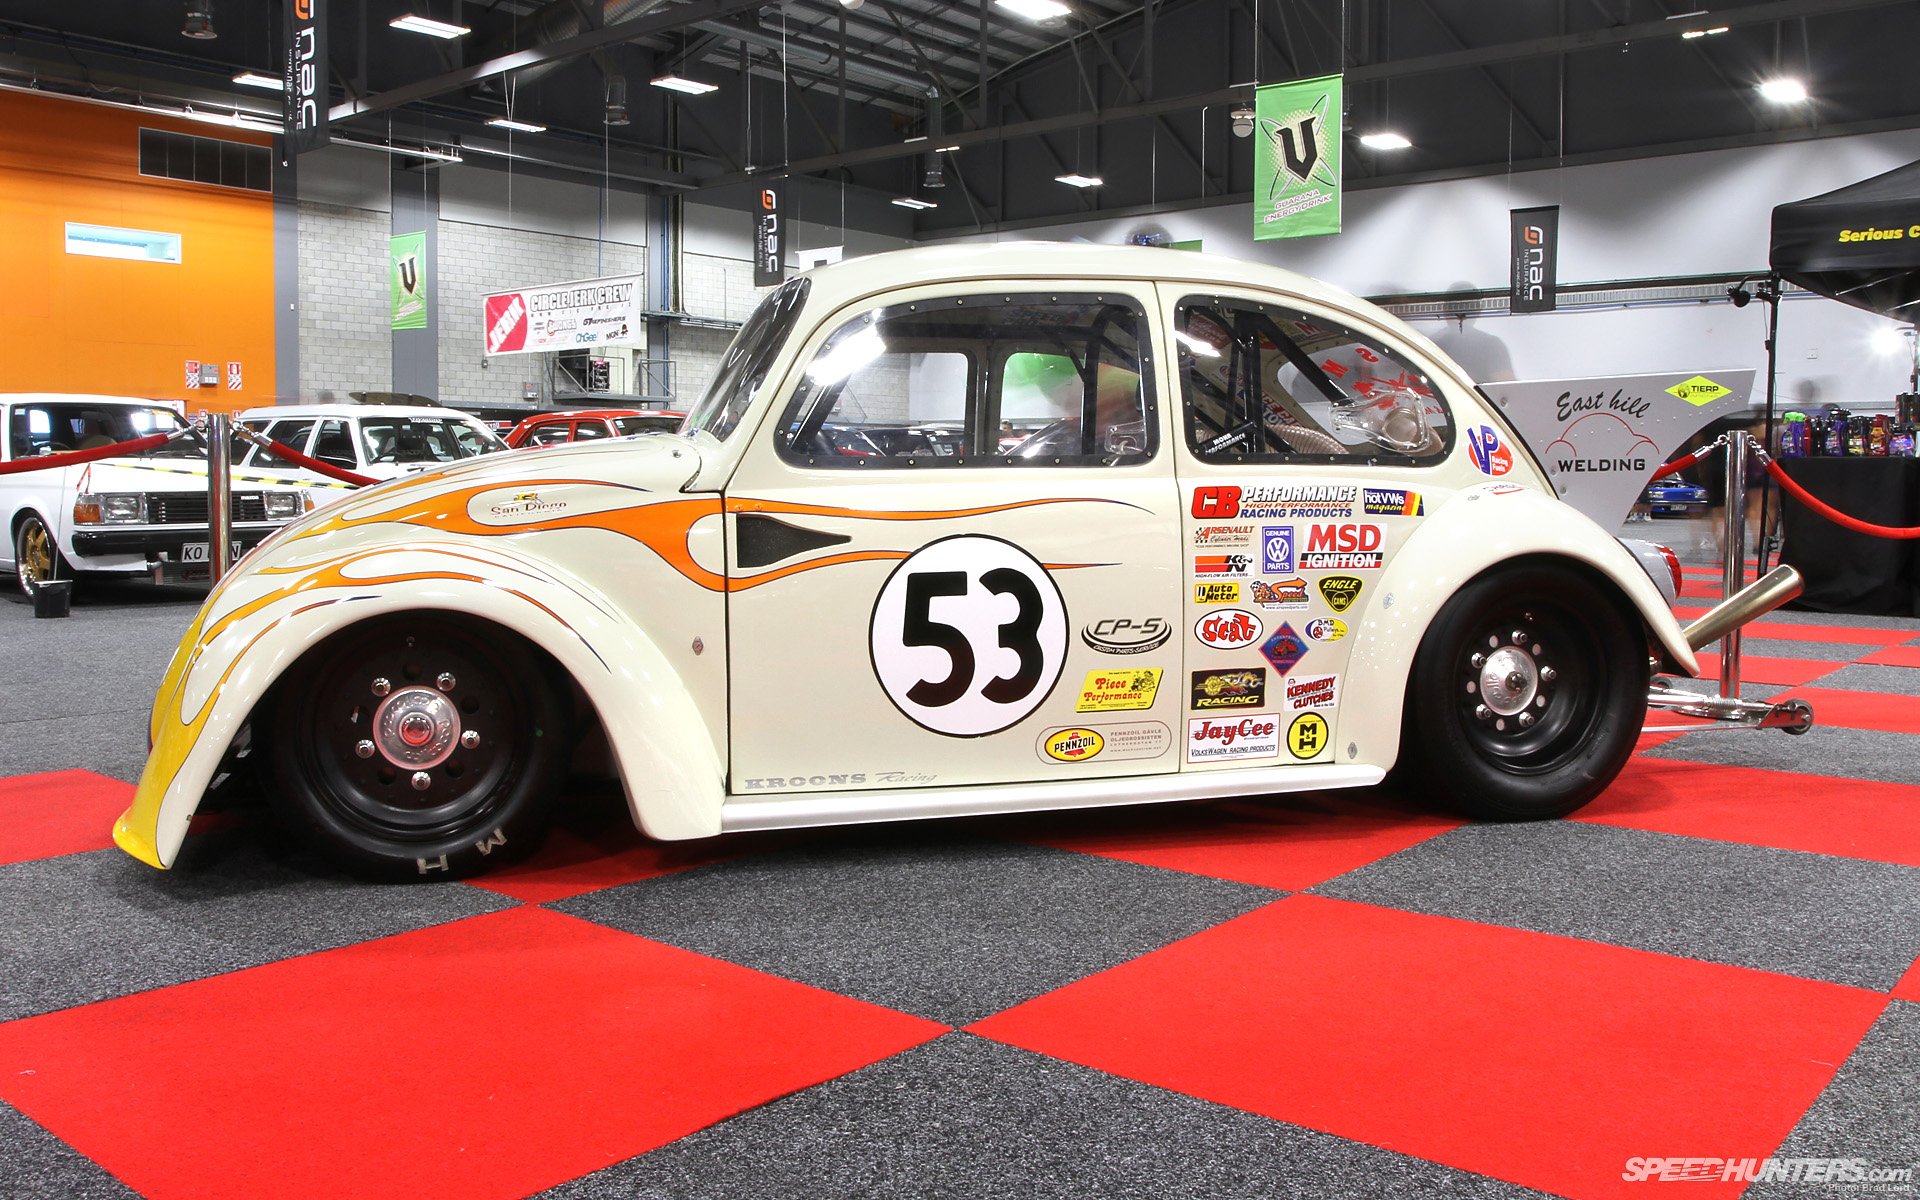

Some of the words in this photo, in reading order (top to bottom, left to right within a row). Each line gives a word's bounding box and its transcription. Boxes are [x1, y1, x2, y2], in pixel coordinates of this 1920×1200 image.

[301, 27, 317, 129] nac
[1276, 116, 1318, 180] V
[1264, 206, 1300, 223] ENERGY
[1301, 196, 1332, 211] DRINK
[1275, 189, 1320, 210] GUARANA
[767, 213, 778, 273] nac
[1838, 227, 1904, 243] Serious
[1529, 248, 1544, 300] nac
[530, 292, 568, 312] CIRCLE
[568, 288, 596, 308] JERK
[596, 283, 633, 304] CREW
[489, 296, 525, 353] JERK
[1556, 390, 1604, 422] East
[1608, 388, 1651, 418] hill
[1466, 424, 1499, 475] VP
[1558, 459, 1646, 472] WELDING
[491, 506, 519, 516] San
[525, 501, 567, 512] Diego
[1191, 485, 1242, 519] CB
[1241, 485, 1357, 503] PERFORMANCE
[1240, 509, 1287, 518] RACING
[1289, 508, 1352, 518] PRODUCTS
[1197, 526, 1255, 539] ARSENAULT
[1307, 524, 1381, 552] MSD
[1305, 553, 1377, 568] IGNITION
[1207, 585, 1233, 593] Auto
[1322, 580, 1359, 589] ENGLE
[1205, 592, 1238, 601] Meter
[1093, 617, 1163, 635] CP-S
[1202, 612, 1257, 642] Scat
[902, 567, 1044, 708] 53
[1286, 676, 1336, 698] KENNEDY
[1084, 692, 1142, 704] Performance
[1196, 695, 1260, 707] RACING
[1293, 690, 1334, 709] CLUTCHES
[1194, 718, 1274, 746] JayCee
[1054, 736, 1096, 753] PENNZOIL
[1229, 746, 1249, 754] RACING
[1249, 744, 1276, 752] PRODUCTS
[744, 773, 867, 790] KROONS
